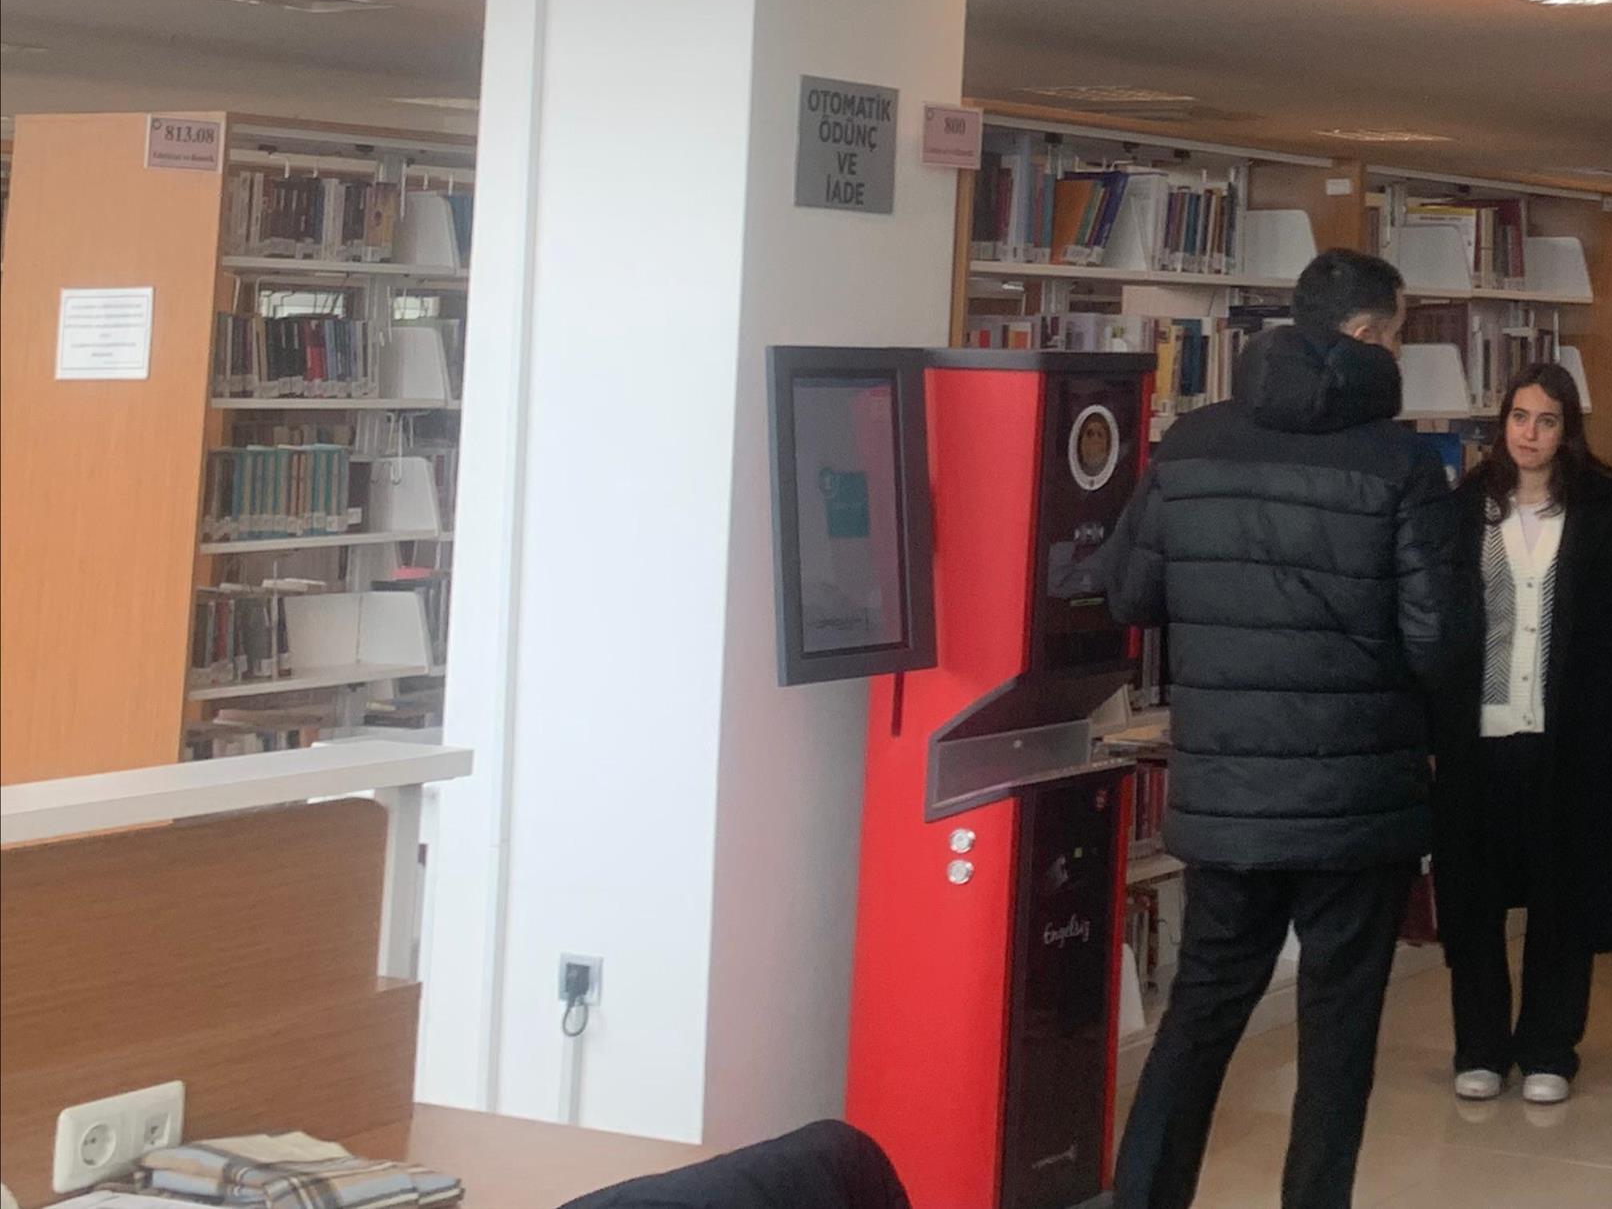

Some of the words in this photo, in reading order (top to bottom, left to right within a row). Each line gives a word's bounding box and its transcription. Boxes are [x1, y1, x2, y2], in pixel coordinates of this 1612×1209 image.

[807, 89, 892, 122] OTOMATİK
[819, 115, 878, 151] ÖDÜNÇ
[836, 151, 858, 175] VE
[826, 174, 865, 205] İADE
